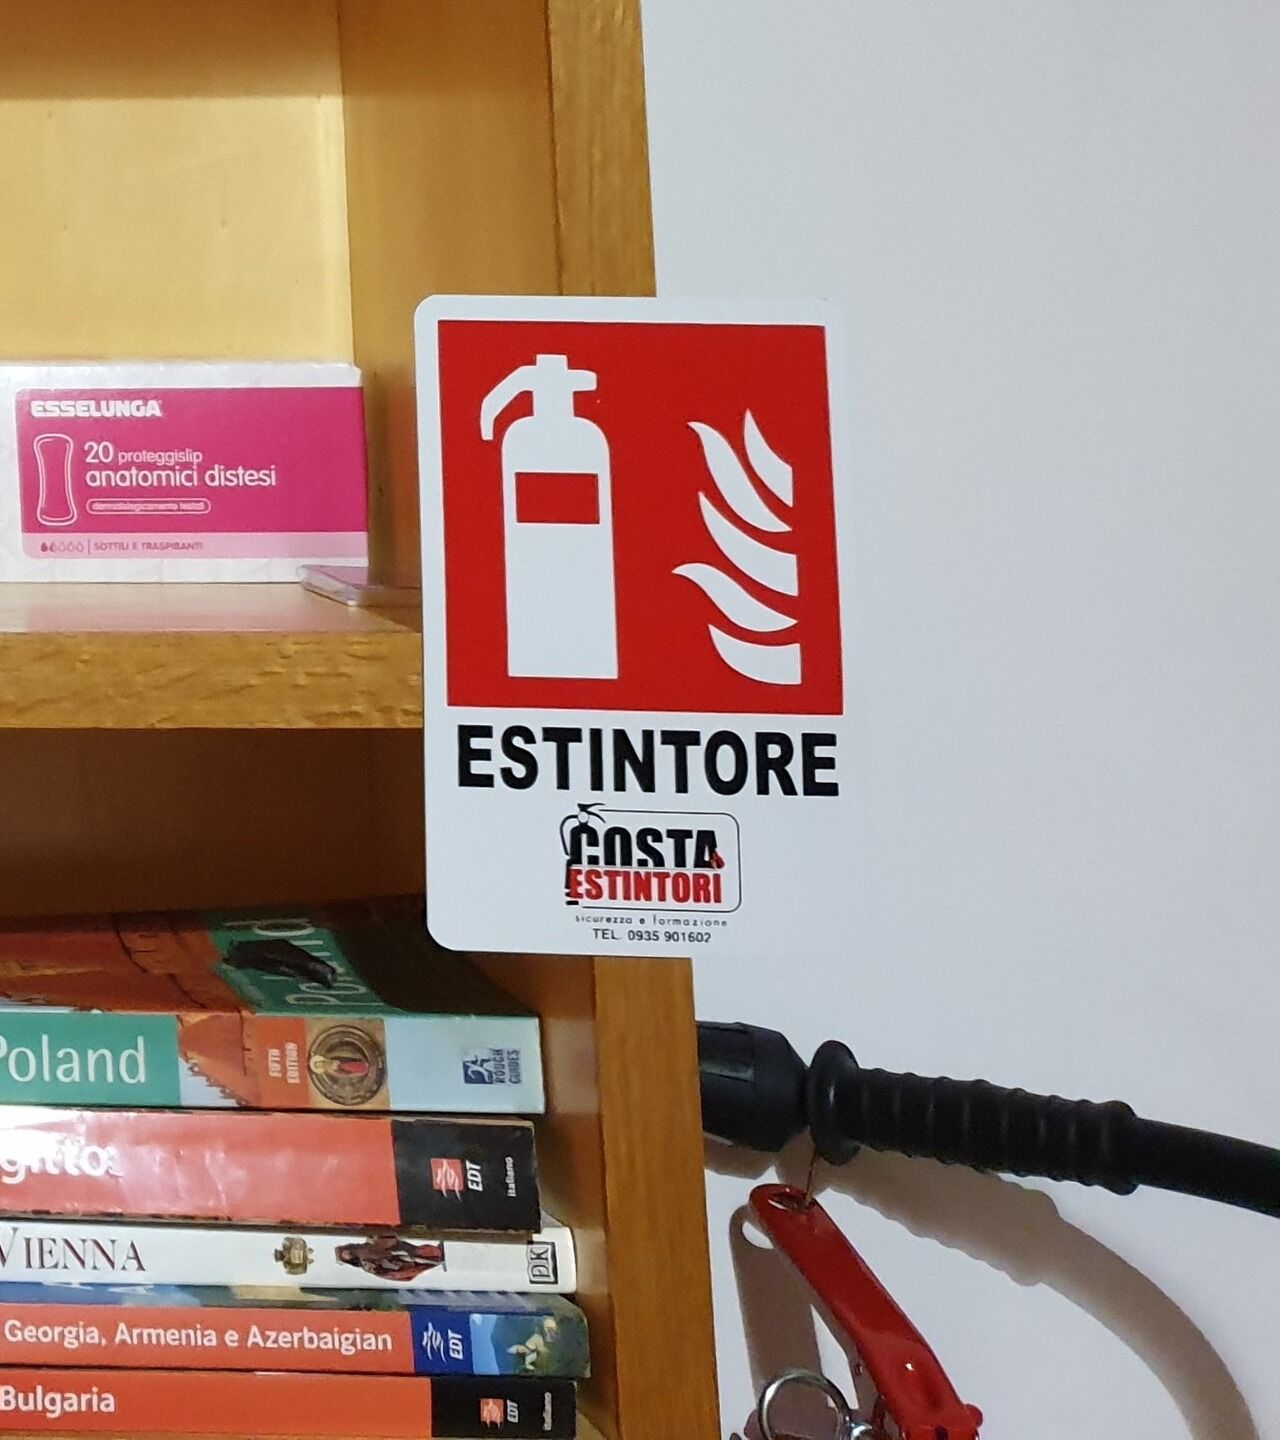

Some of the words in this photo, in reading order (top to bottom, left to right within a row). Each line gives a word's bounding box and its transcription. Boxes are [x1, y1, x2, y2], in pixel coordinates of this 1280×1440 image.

[31, 400, 163, 418] ESSELUNGA
[84, 441, 114, 463] 20
[118, 448, 203, 466] proteggislip
[85, 466, 198, 488] anatomici
[204, 465, 277, 488] distesi
[140, 541, 203, 551] TRASPIRANTI
[457, 724, 840, 797] ESTINTORE
[570, 824, 721, 869] COSTA
[569, 868, 723, 904] ESTINTORI
[575, 914, 633, 926] sicurezza
[652, 914, 729, 928] formazione
[627, 929, 660, 942] 0935
[663, 931, 712, 944] 901602
[285, 1041, 301, 1084] EDITION
[493, 1047, 505, 1086] ROUGH
[506, 1047, 522, 1085] GUIDES
[465, 1160, 484, 1192] EDT
[504, 1156, 516, 1198] italiano
[531, 1245, 551, 1279] DK
[3, 1318, 107, 1350] Georgia,
[114, 1321, 217, 1348] Armenia
[223, 1332, 239, 1348] e
[246, 1324, 393, 1356] Azerbaigian
[447, 1328, 465, 1361] EDT
